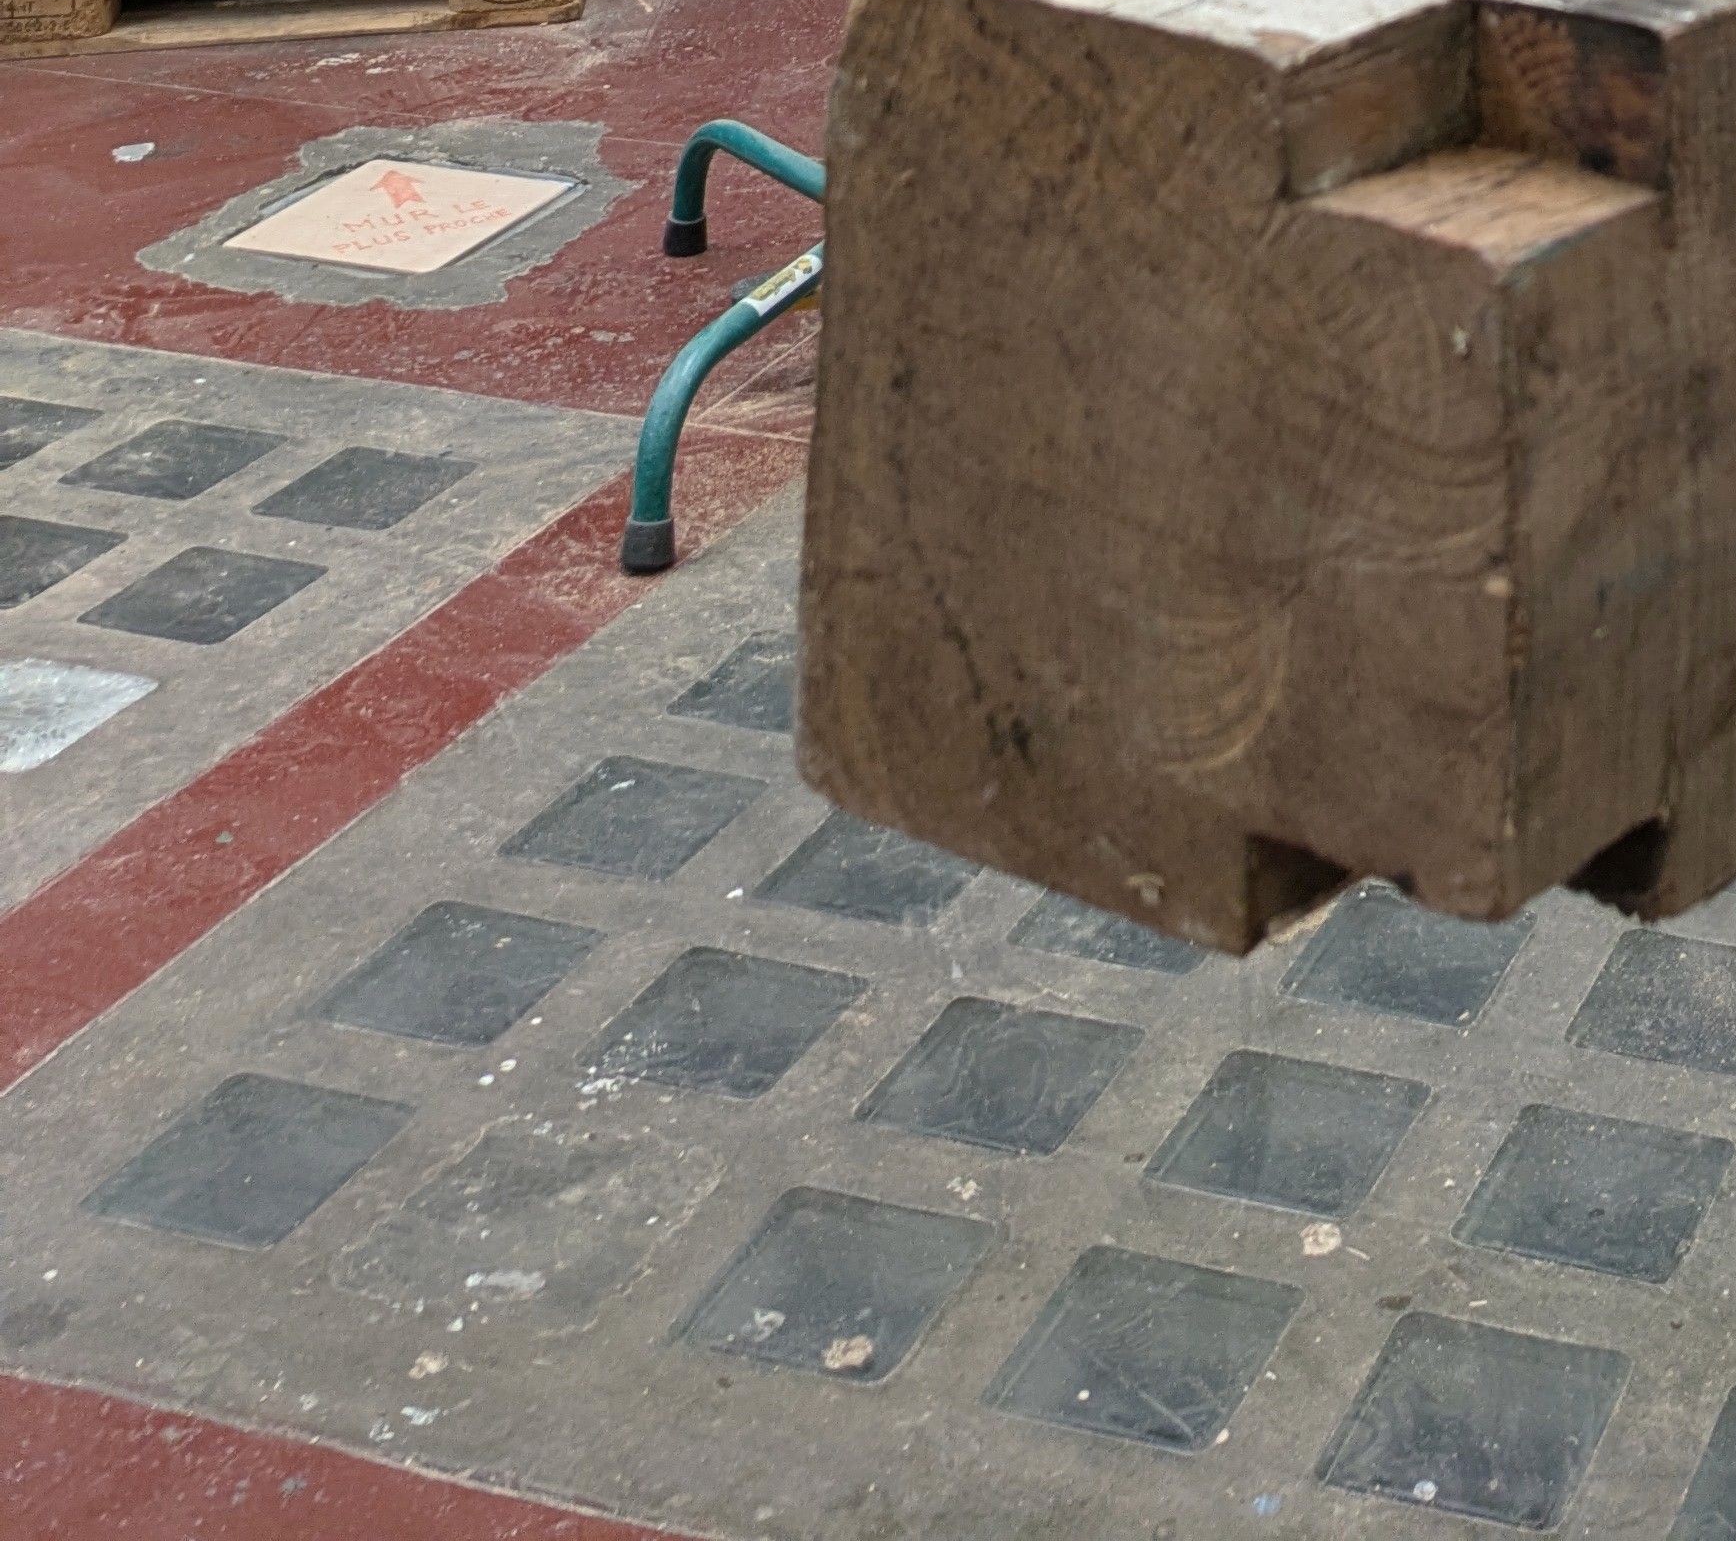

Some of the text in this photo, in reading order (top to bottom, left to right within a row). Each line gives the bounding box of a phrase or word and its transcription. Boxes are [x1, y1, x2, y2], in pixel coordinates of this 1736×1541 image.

[332, 208, 511, 253] PLUS PROCHE
[342, 200, 491, 233] MUR LE
